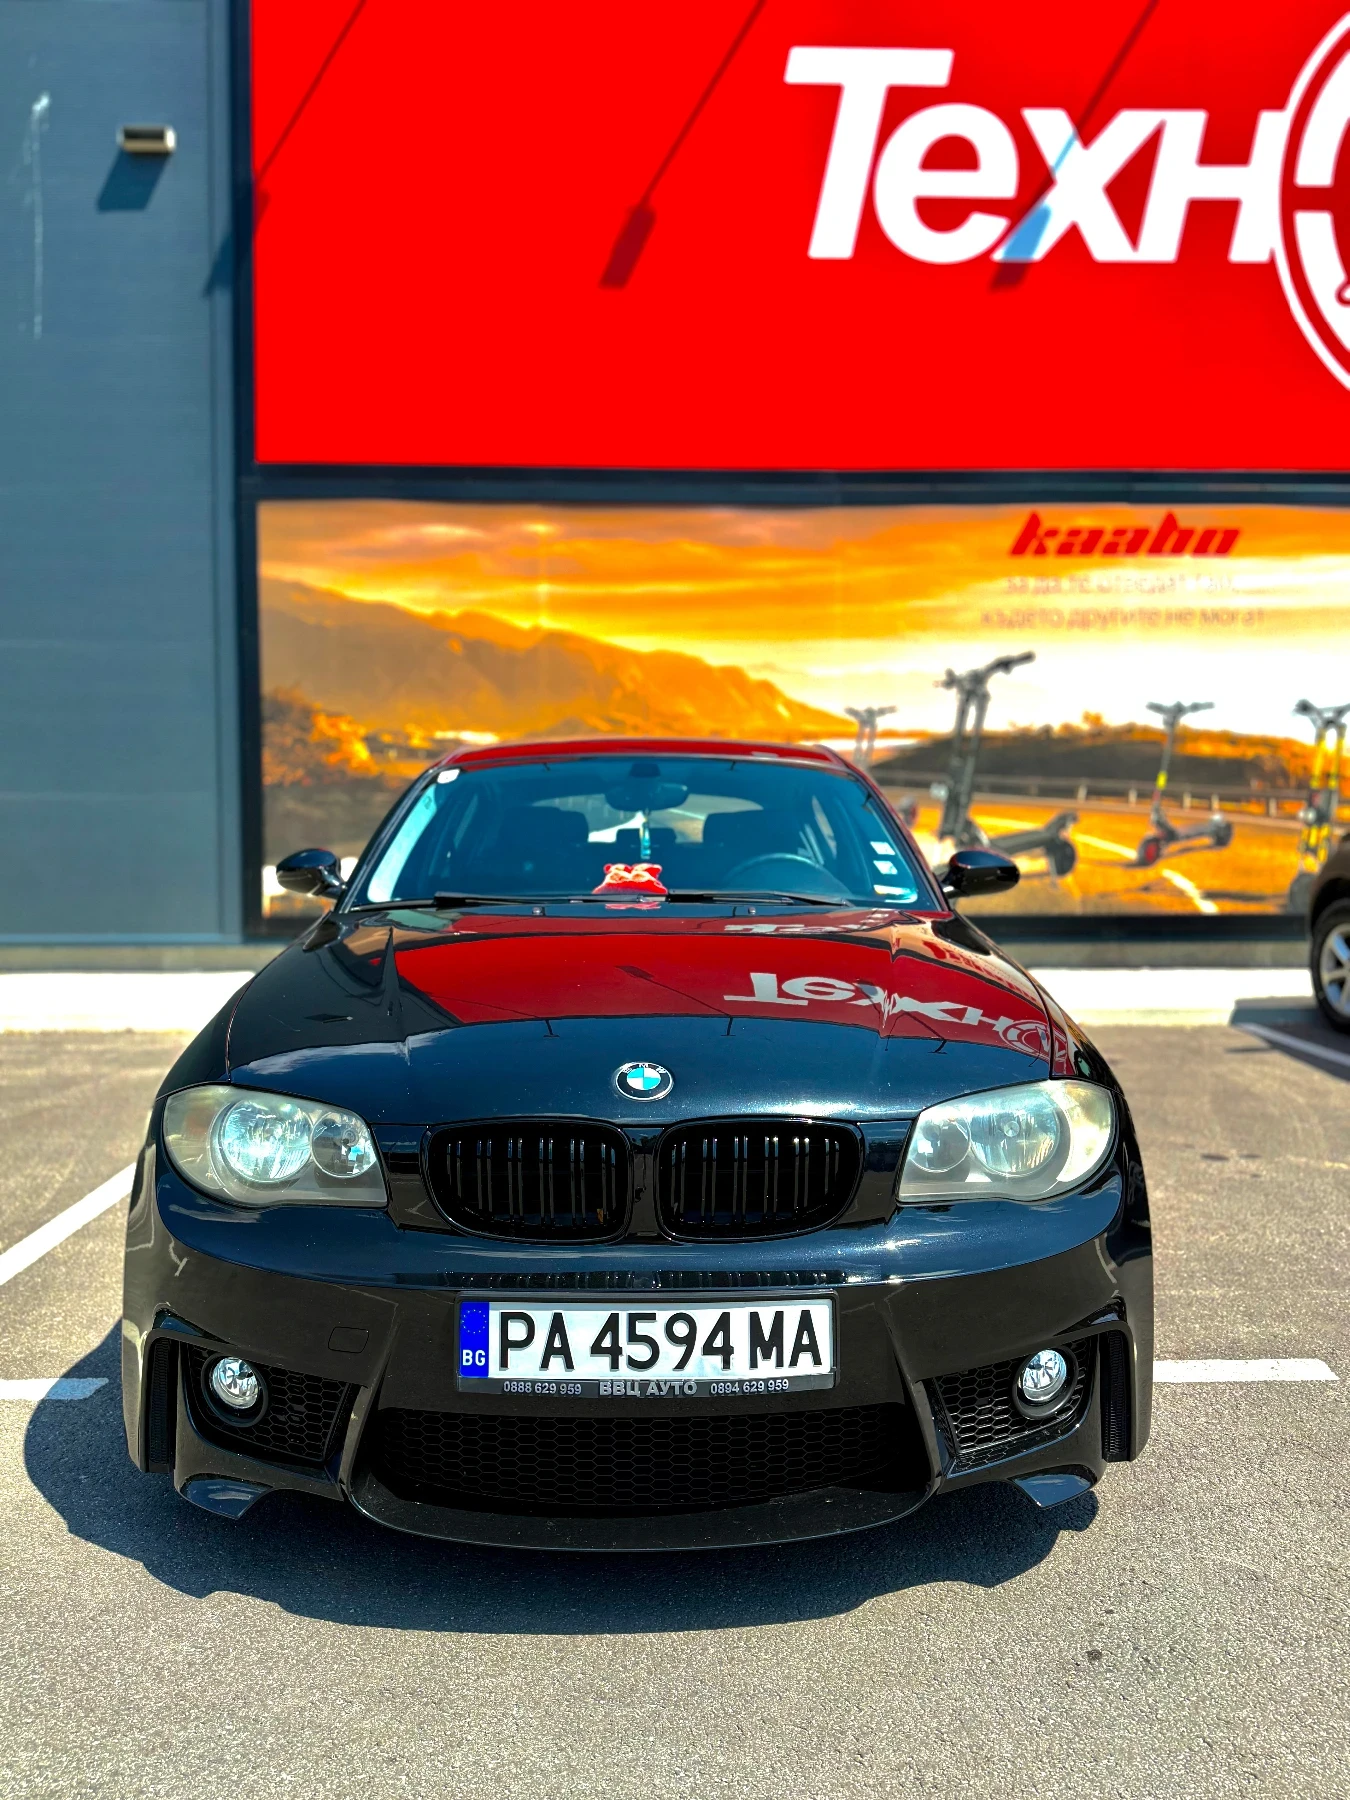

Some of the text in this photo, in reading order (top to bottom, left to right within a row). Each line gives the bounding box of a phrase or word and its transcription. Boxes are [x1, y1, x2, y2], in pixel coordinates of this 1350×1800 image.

[784, 30, 1350, 310] Техн
[499, 1309, 823, 1371] PA 4594 MA
[461, 1349, 486, 1366] BG
[503, 1381, 582, 1396] 0888 629 959
[646, 1380, 698, 1396] АУТО
[710, 1380, 789, 1395] 0894 629 959
